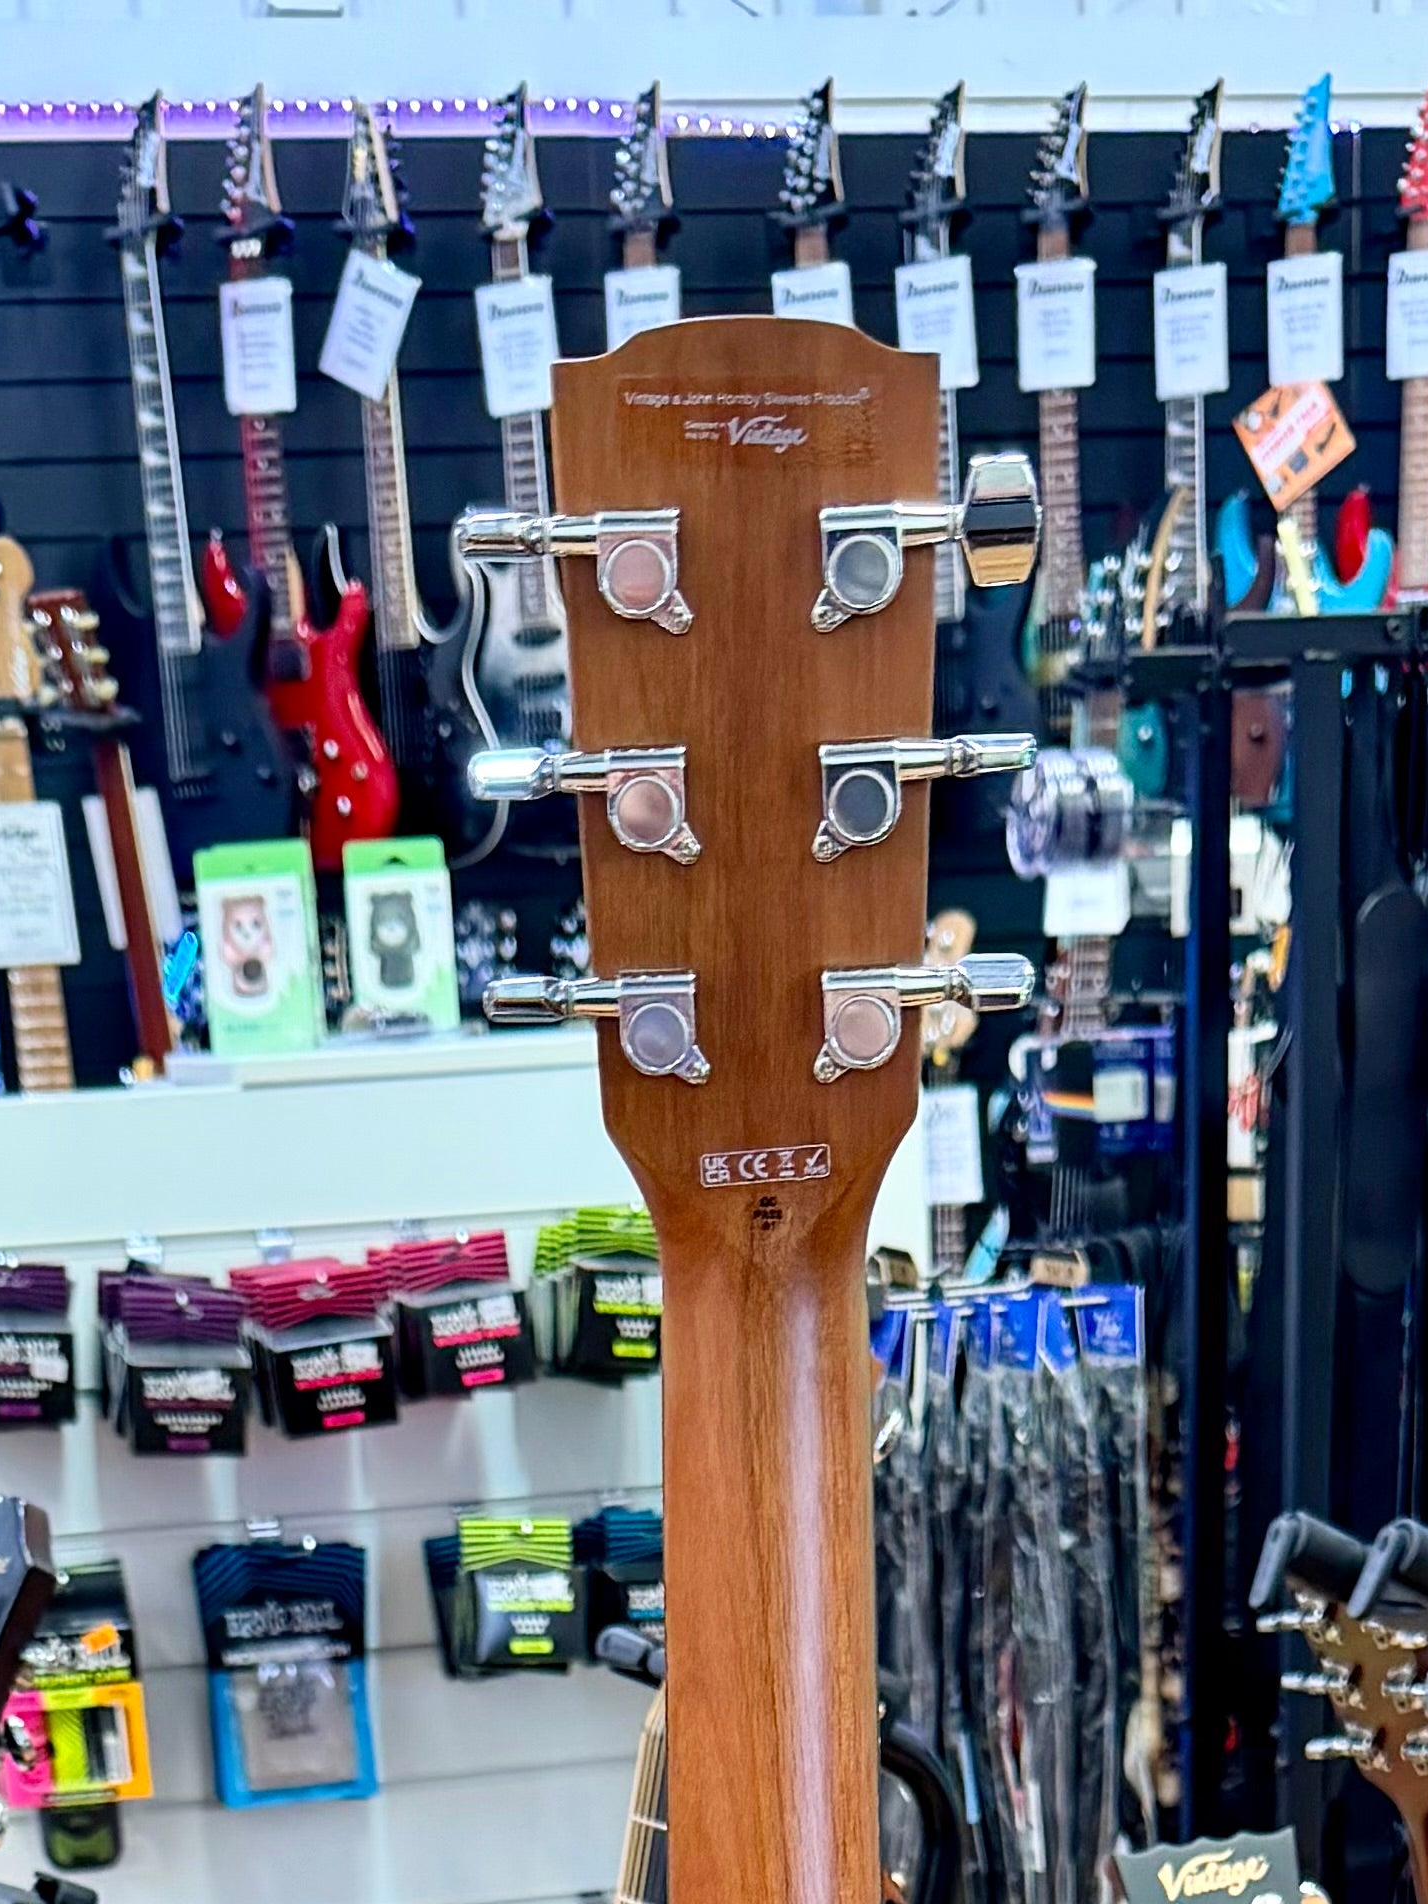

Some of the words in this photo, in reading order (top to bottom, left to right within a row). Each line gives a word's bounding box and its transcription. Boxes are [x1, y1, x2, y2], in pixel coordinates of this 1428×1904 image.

[728, 414, 809, 454] Vintage
[738, 1153, 769, 1179] CE
[1157, 1848, 1270, 1901] Vintage
